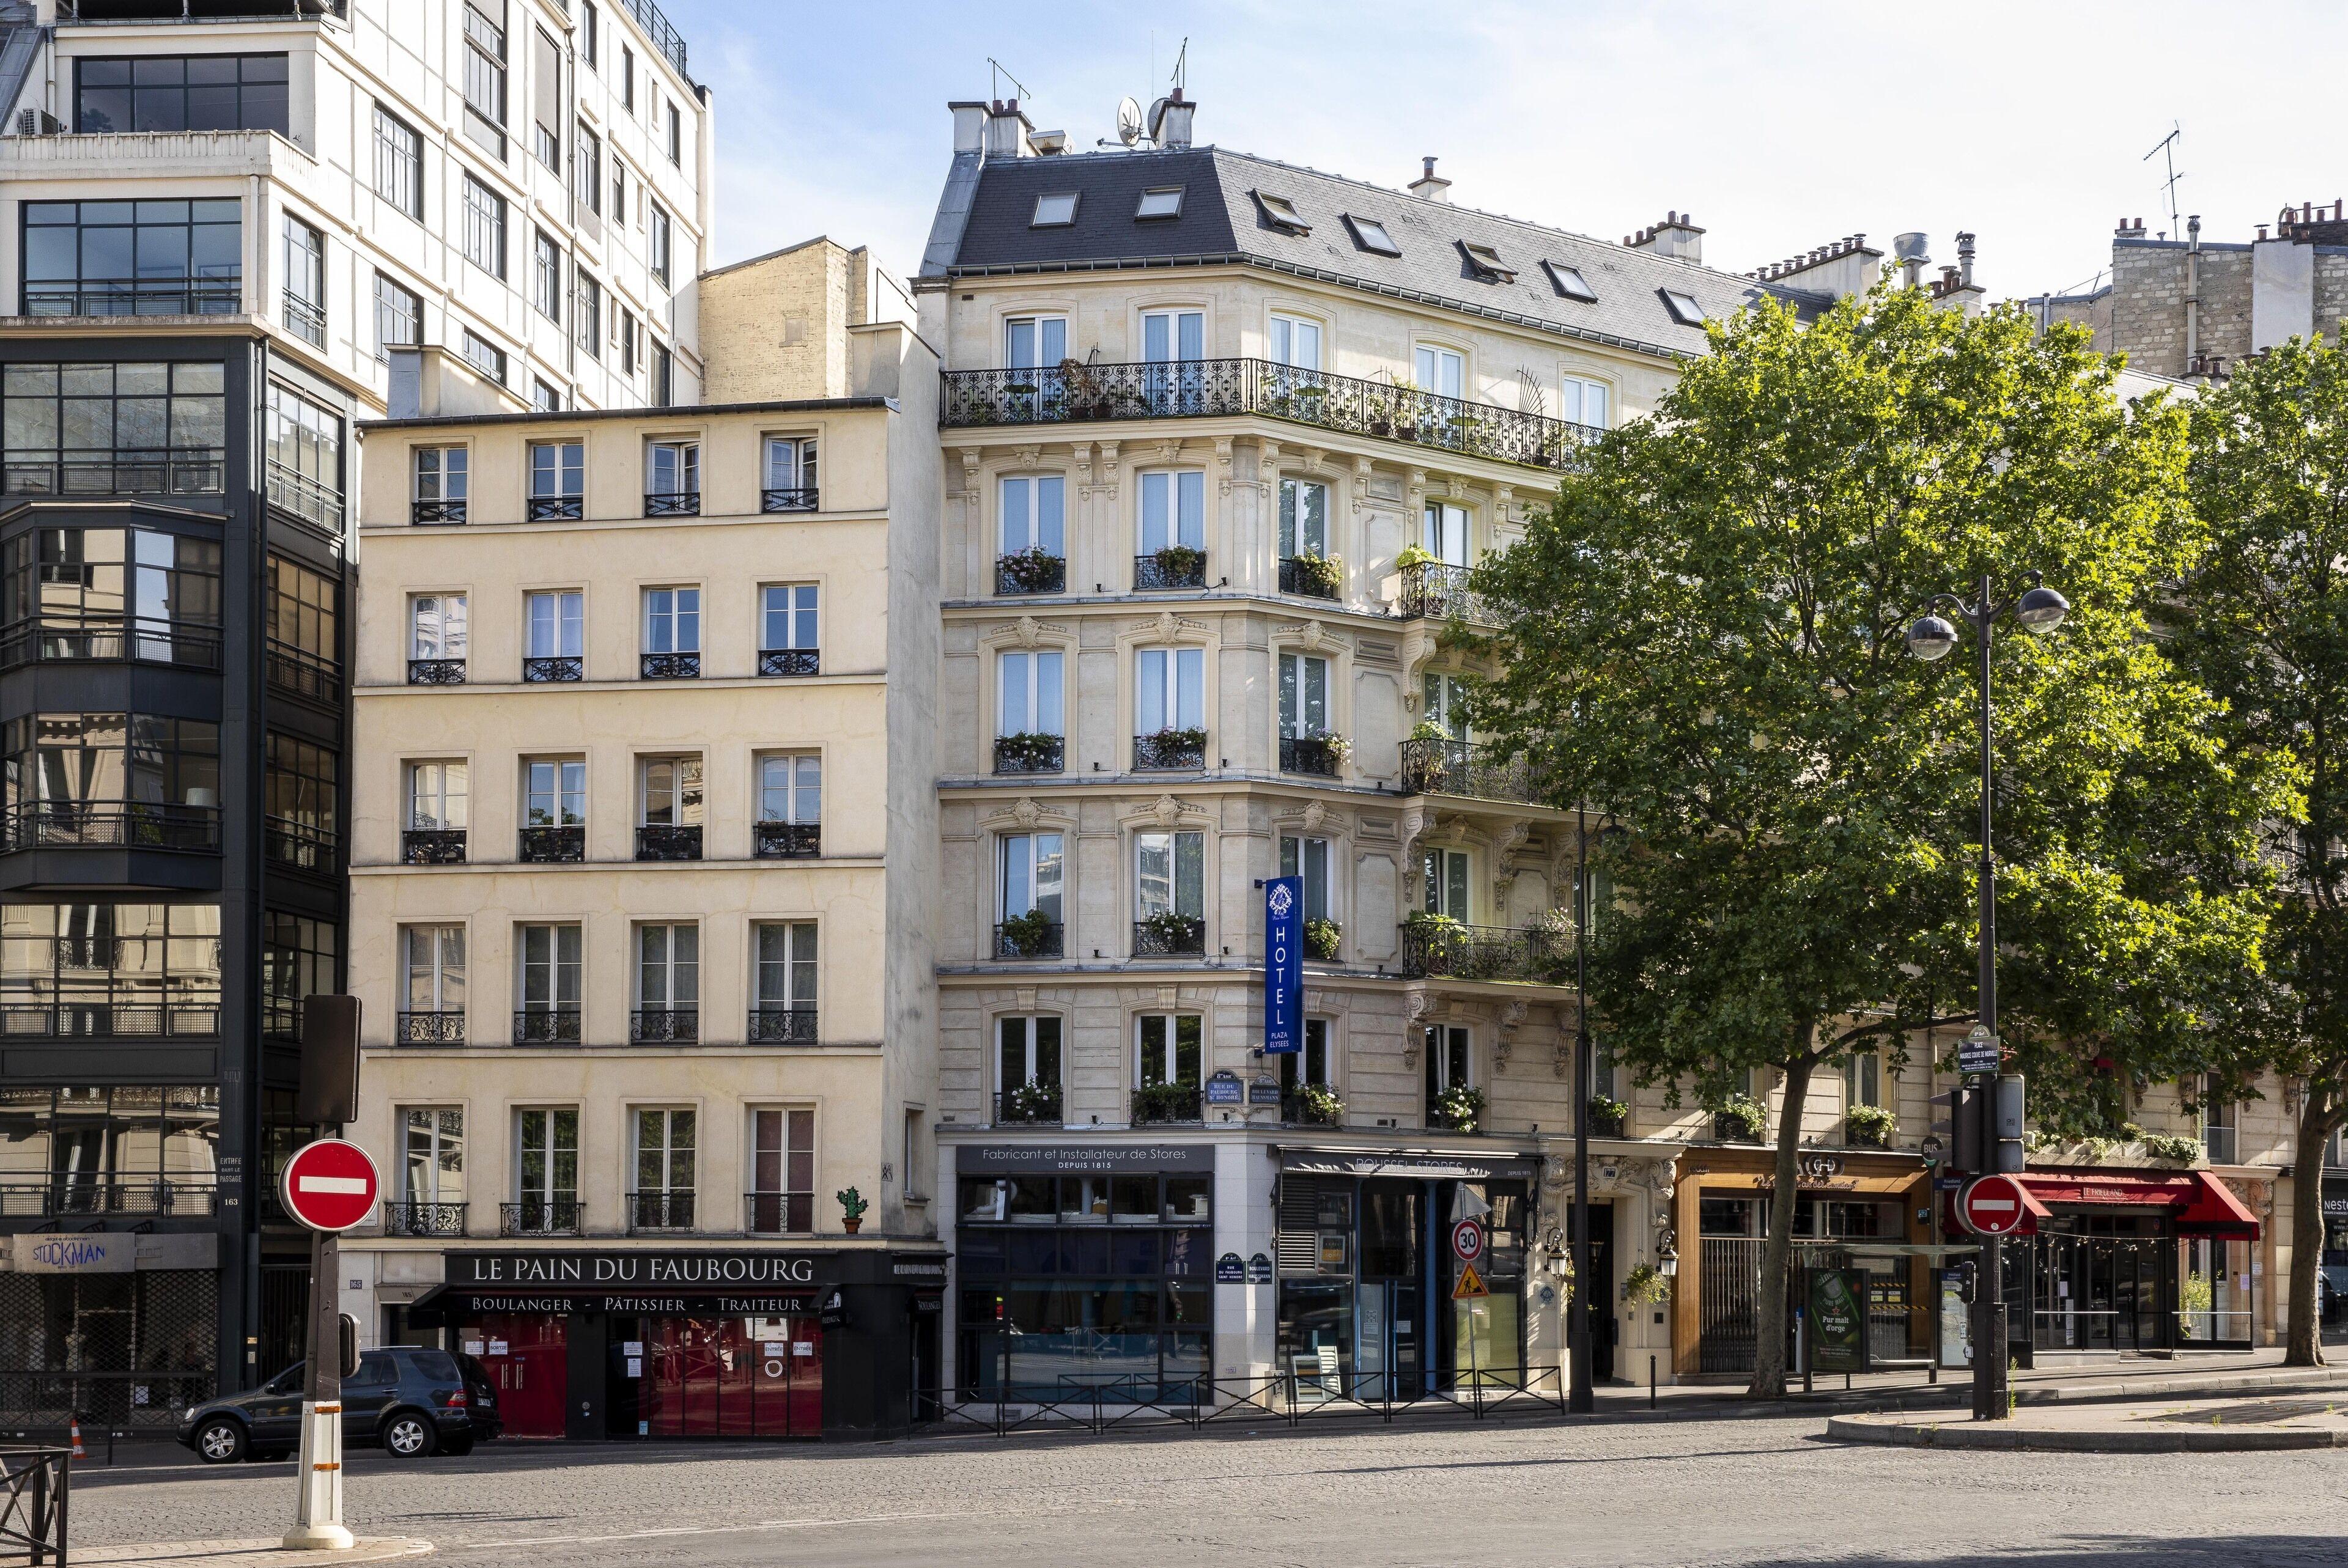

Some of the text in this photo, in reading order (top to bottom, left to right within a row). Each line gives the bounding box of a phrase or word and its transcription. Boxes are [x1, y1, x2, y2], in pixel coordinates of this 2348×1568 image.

[1275, 927, 1286, 1025] HOTEL
[983, 1149, 1187, 1159] Fabricant et Installateur de Stores
[1924, 1144, 1938, 1153] BUS
[1356, 1158, 1463, 1174] ROUSSEL STORES
[1604, 1168, 1615, 1177] 177
[2092, 1188, 2123, 1196] FRIEDLAND
[1460, 1232, 1476, 1249] 30
[33, 1242, 105, 1265] STOCKMAN
[474, 1258, 813, 1281] LE PAIN DU FAUBOURG
[1822, 1297, 1834, 1306] PURE
